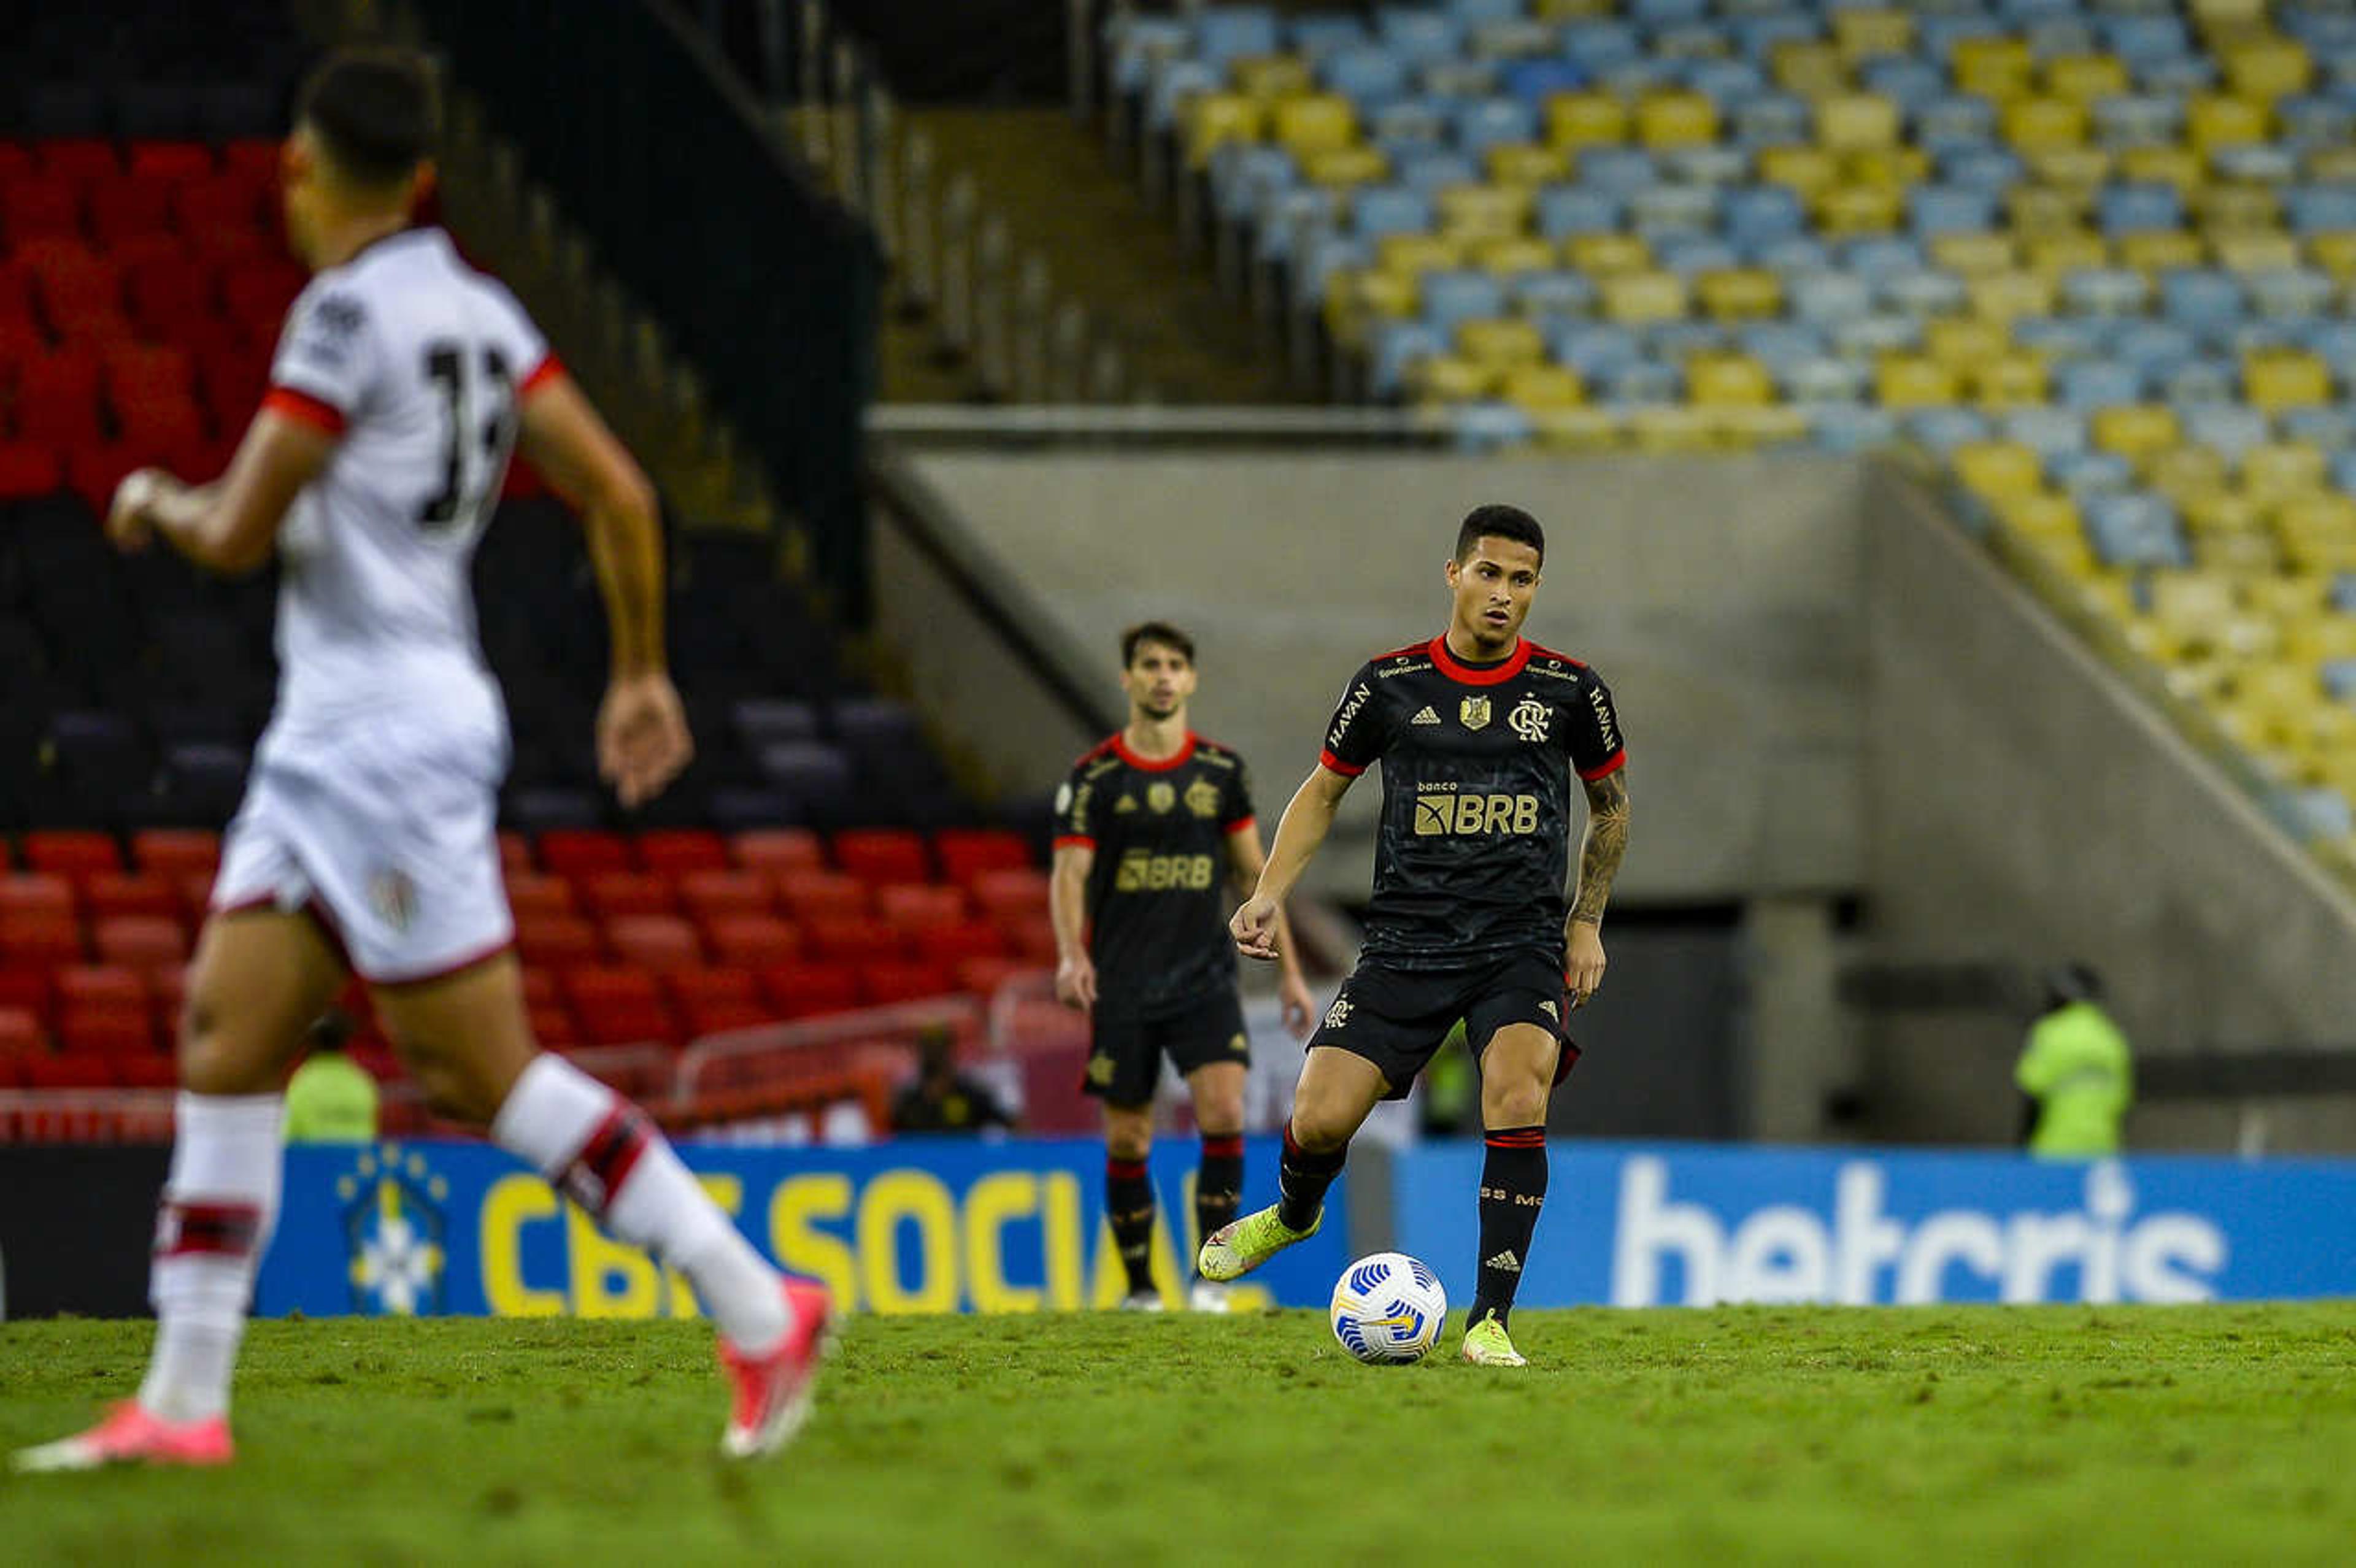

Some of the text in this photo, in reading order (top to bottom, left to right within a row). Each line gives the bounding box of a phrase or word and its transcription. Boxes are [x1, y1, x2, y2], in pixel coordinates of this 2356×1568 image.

[1329, 682, 1371, 748] HAVAN
[1590, 685, 1615, 751] HAVAN
[1417, 782, 1458, 792] banco
[1455, 794, 1539, 835] BRB
[1611, 1155, 2226, 1308] betcris
